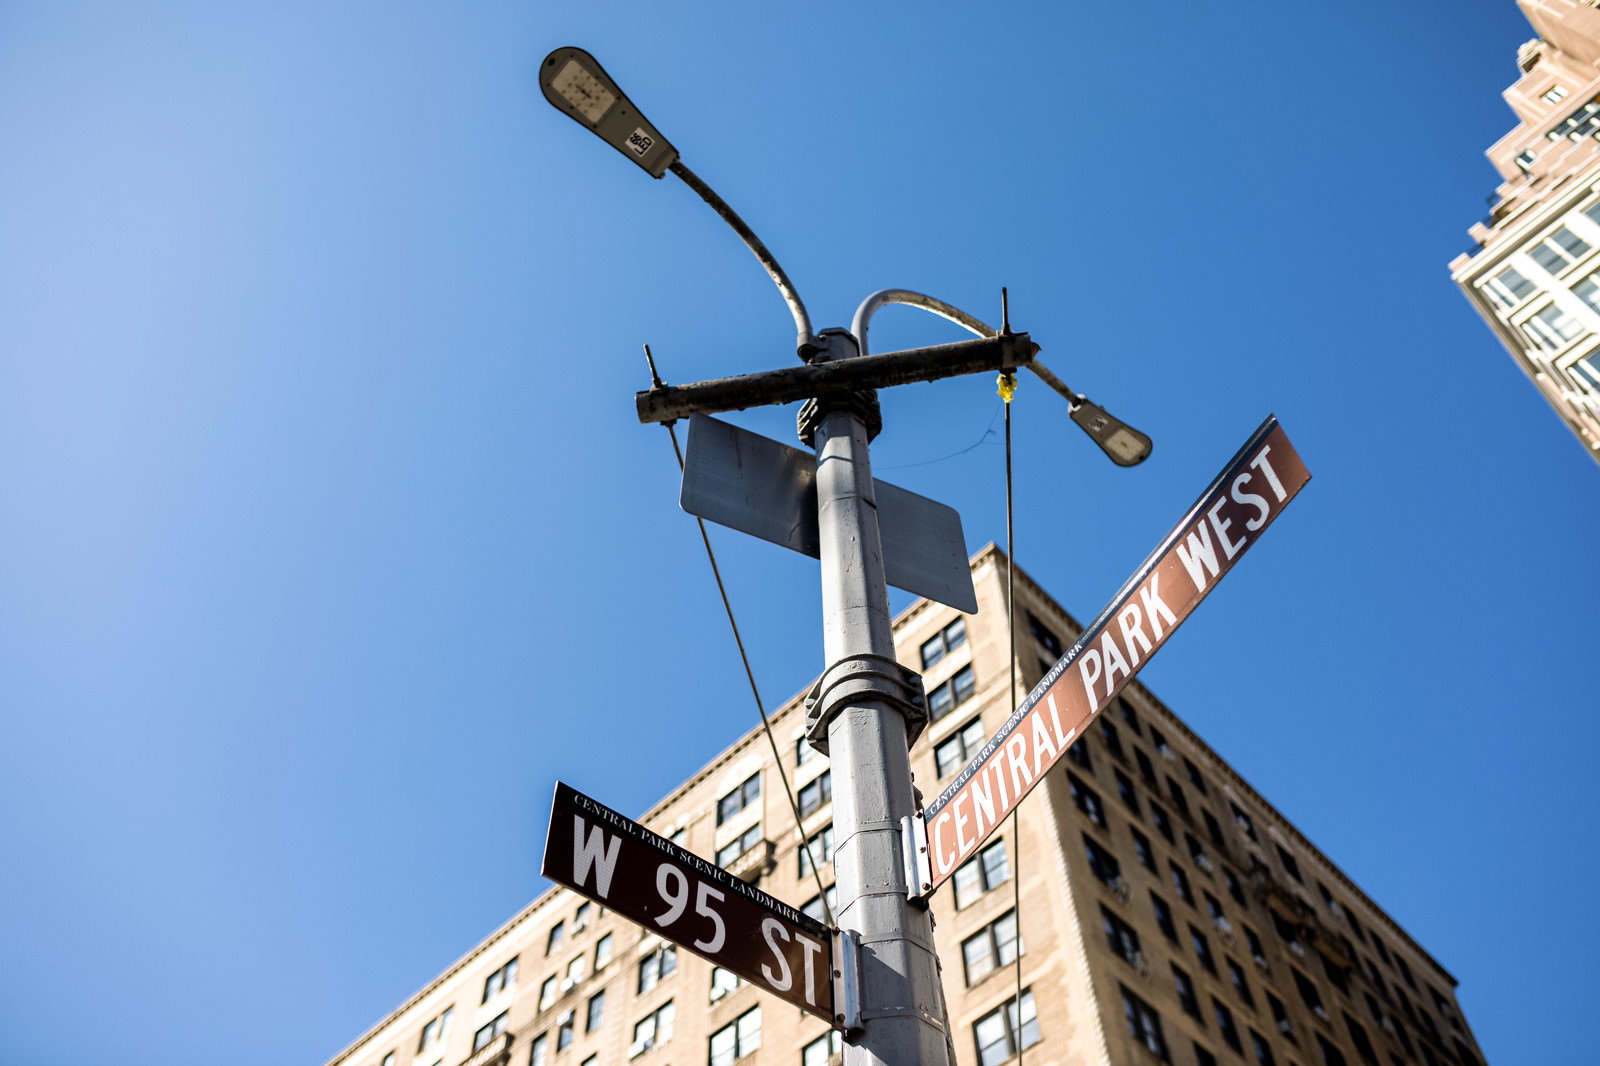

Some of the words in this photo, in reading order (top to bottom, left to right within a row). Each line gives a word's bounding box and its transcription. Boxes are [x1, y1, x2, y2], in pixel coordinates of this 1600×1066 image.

[634, 137, 653, 155] LED
[930, 769, 971, 815] CENTRAL
[971, 740, 996, 771] PARK
[997, 702, 1030, 742] SCENIC
[1030, 641, 1083, 704] LANDMARK
[934, 693, 1077, 876] CENTRAL
[1078, 571, 1178, 714] PARK
[1176, 444, 1288, 593] WEST
[573, 814, 622, 900] W
[653, 862, 726, 954] 95
[760, 917, 822, 1007] ST
[574, 794, 636, 835] CENTRAL
[641, 830, 675, 856] PARK
[679, 851, 726, 883] SCENIC
[730, 879, 800, 924] LANDMARK
